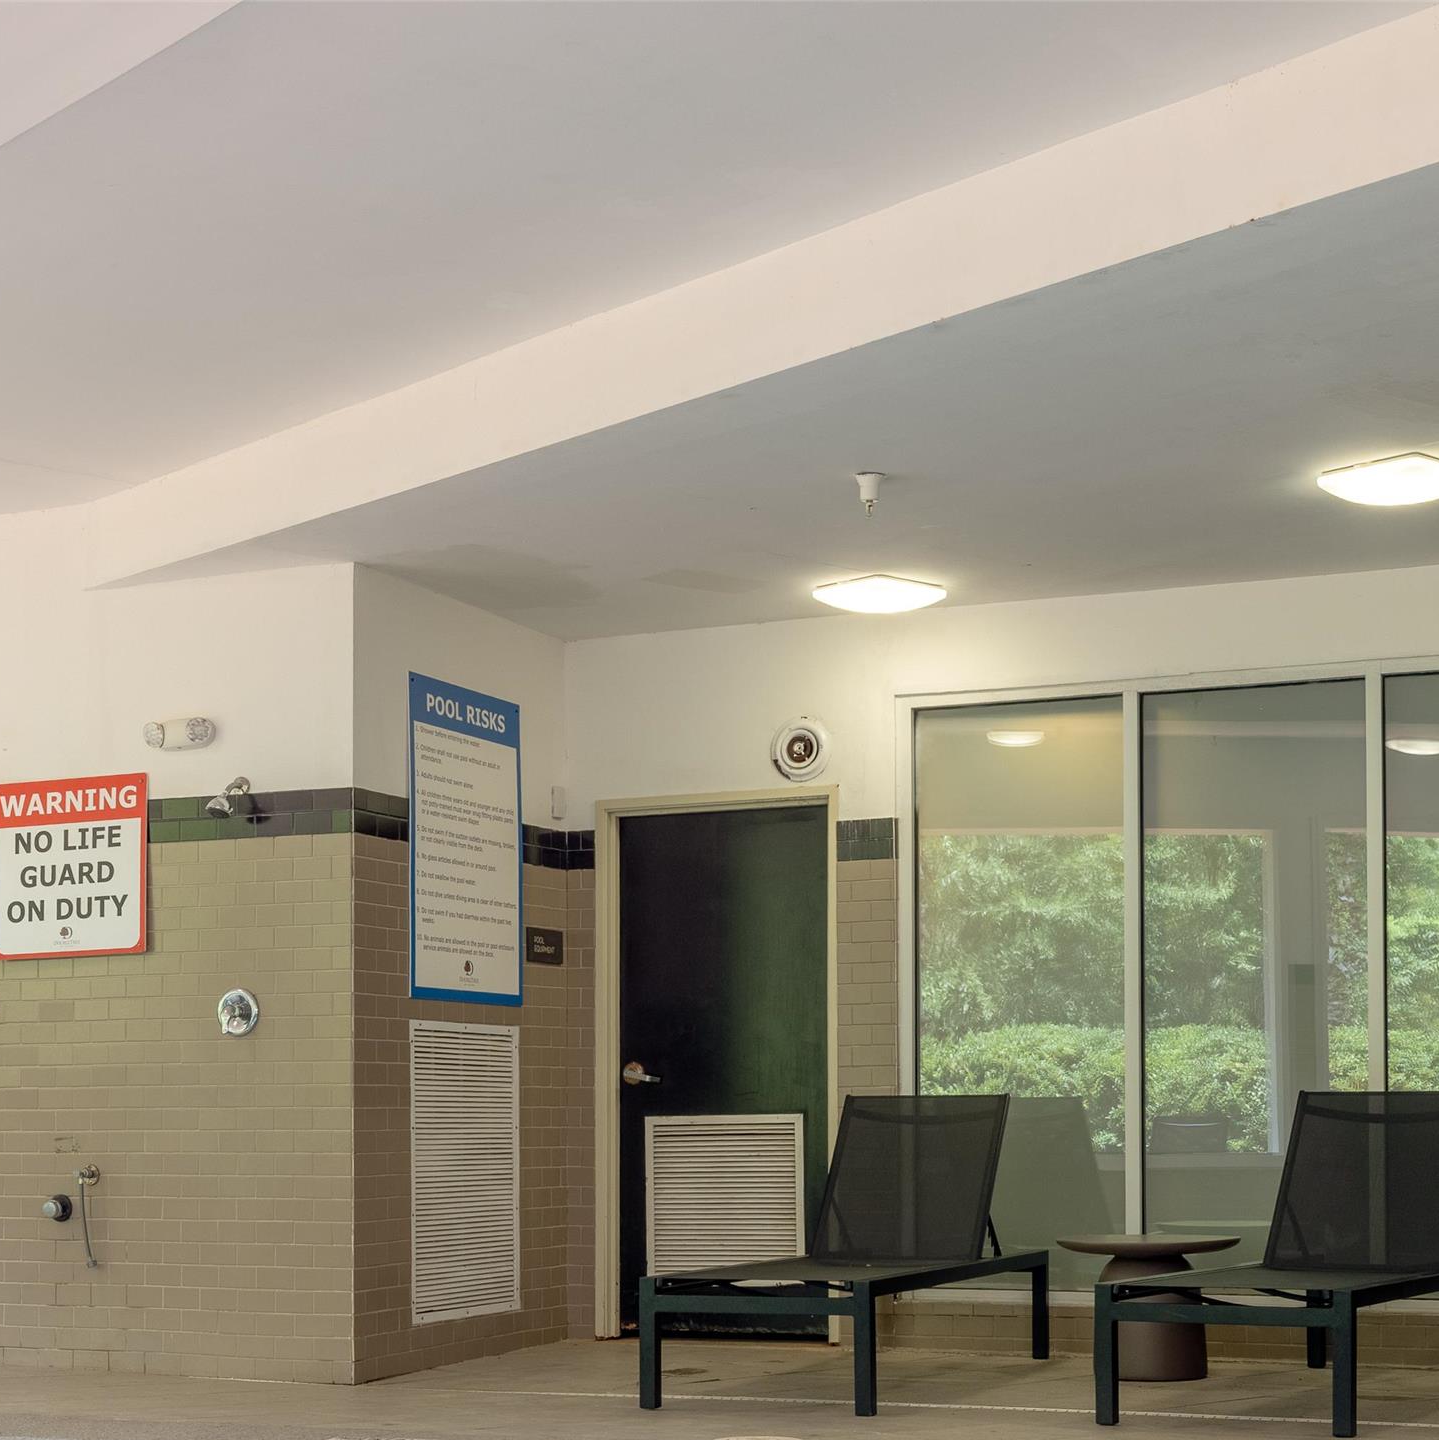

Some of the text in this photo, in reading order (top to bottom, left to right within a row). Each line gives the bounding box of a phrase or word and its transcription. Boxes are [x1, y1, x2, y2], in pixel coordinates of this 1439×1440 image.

[426, 692, 505, 733] POOL RISKS
[0, 785, 137, 818] WARNING
[14, 825, 121, 854] NO LIFE
[20, 861, 115, 888] GUARD
[7, 899, 45, 923] ON
[56, 894, 128, 921] DUTY
